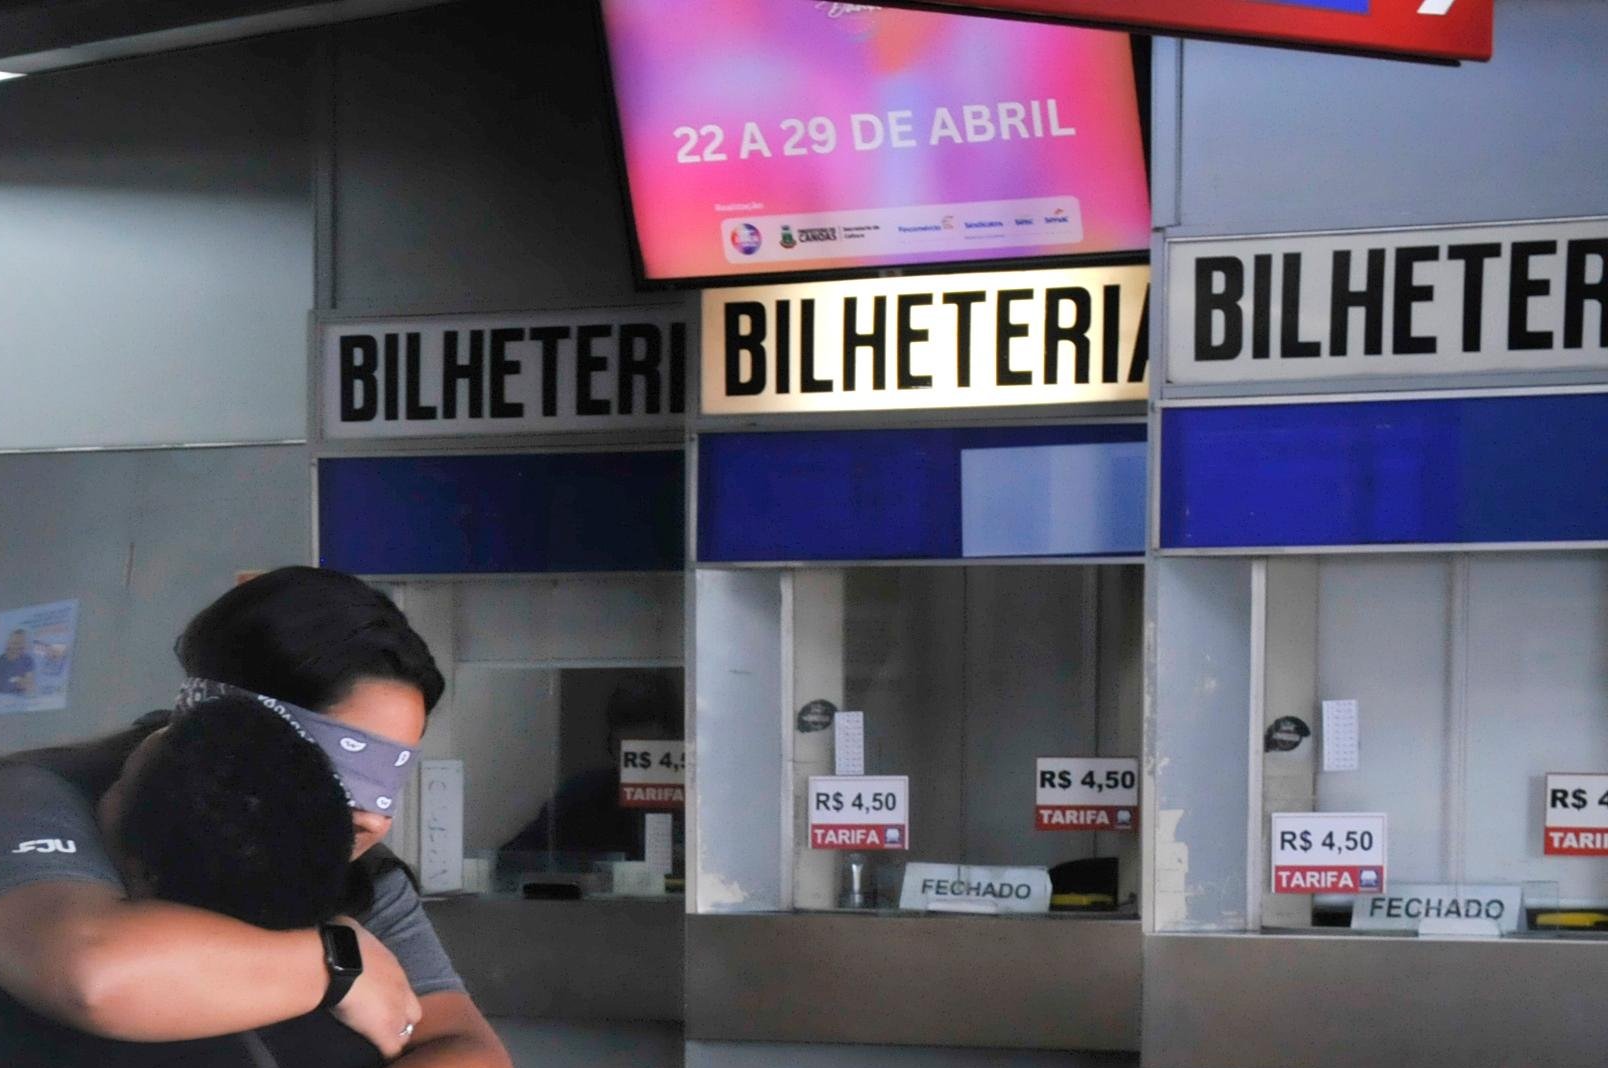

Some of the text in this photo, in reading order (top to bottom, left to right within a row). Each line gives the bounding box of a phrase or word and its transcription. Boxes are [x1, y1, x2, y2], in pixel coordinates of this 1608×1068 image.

[673, 98, 1076, 164] 22 A 29 DE ABRIL
[339, 321, 685, 422] BILHETERI
[623, 750, 652, 770] R$
[1039, 769, 1136, 793] R$ 4,50
[623, 787, 685, 801] TARIFA
[815, 791, 897, 814] R$ 4,50
[1550, 787, 1588, 811] R$
[1039, 809, 1110, 825] TARIFA
[813, 828, 880, 845] TARIFA
[1280, 829, 1374, 854] R$ 4,50
[921, 878, 1032, 901] FECHADO
[1277, 870, 1354, 888] TARIFA
[1368, 896, 1505, 921] FECHADO
